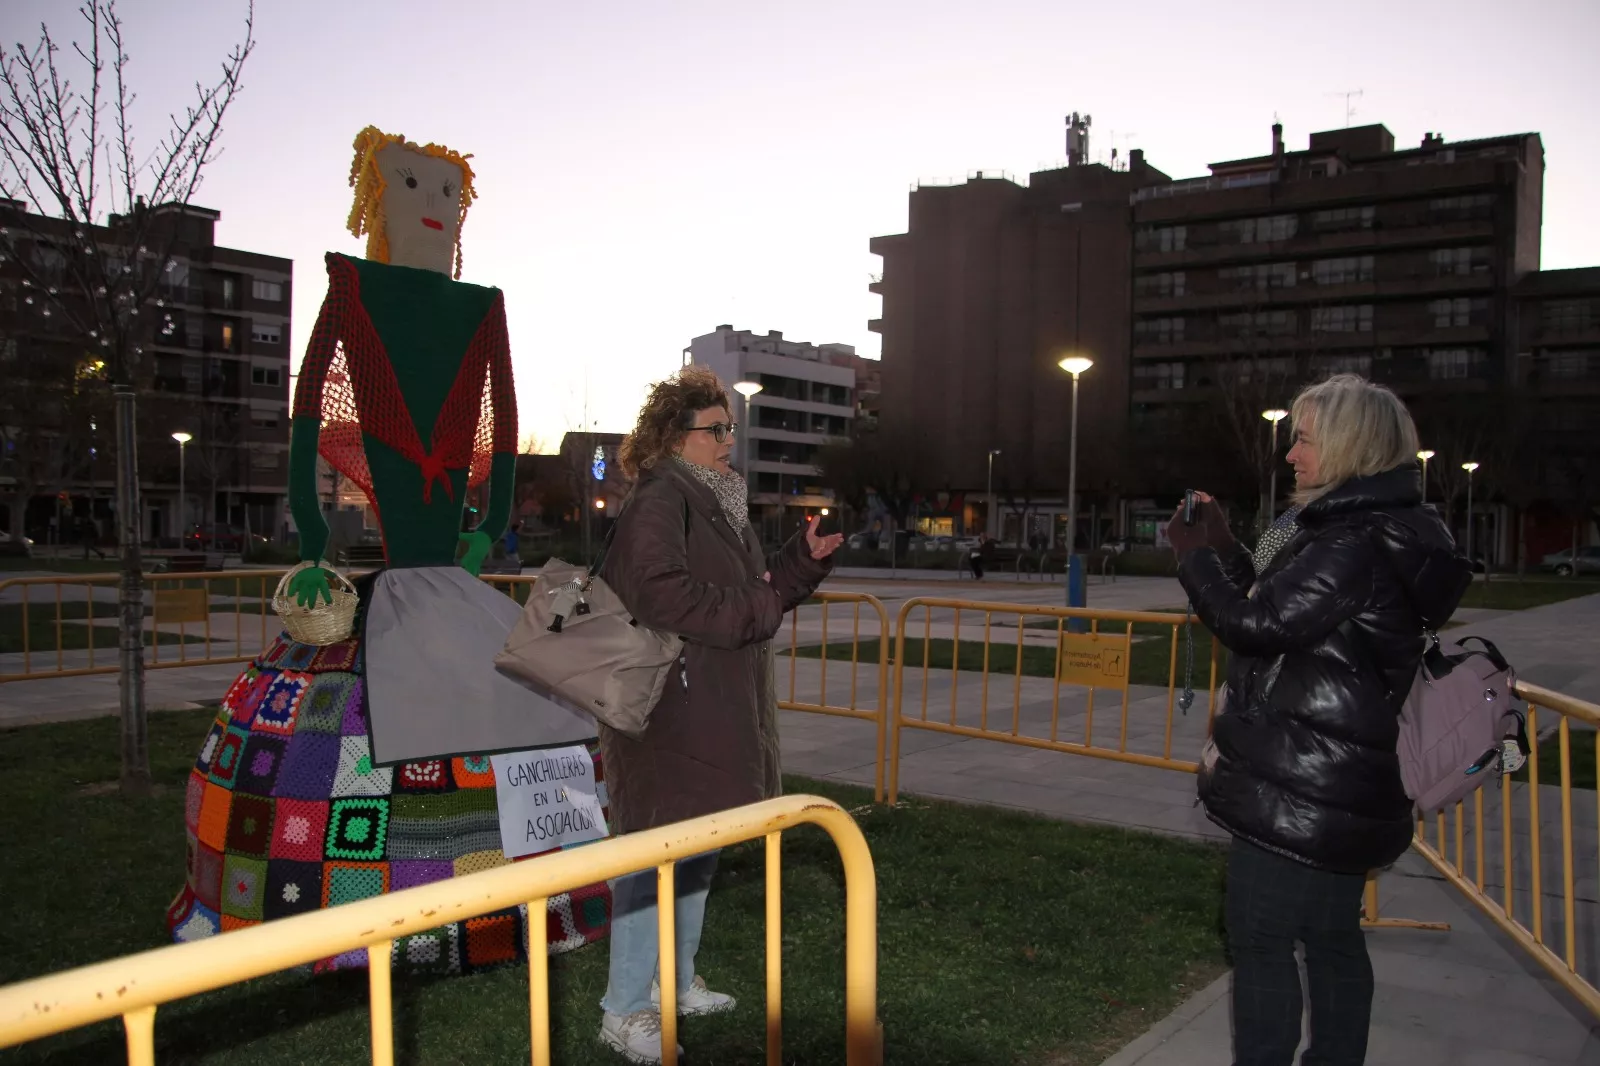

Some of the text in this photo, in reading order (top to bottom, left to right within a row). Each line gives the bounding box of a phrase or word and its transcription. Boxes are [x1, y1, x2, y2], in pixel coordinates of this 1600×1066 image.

[507, 755, 586, 786] GANCHILLERAS
[533, 788, 569, 807] EN LA
